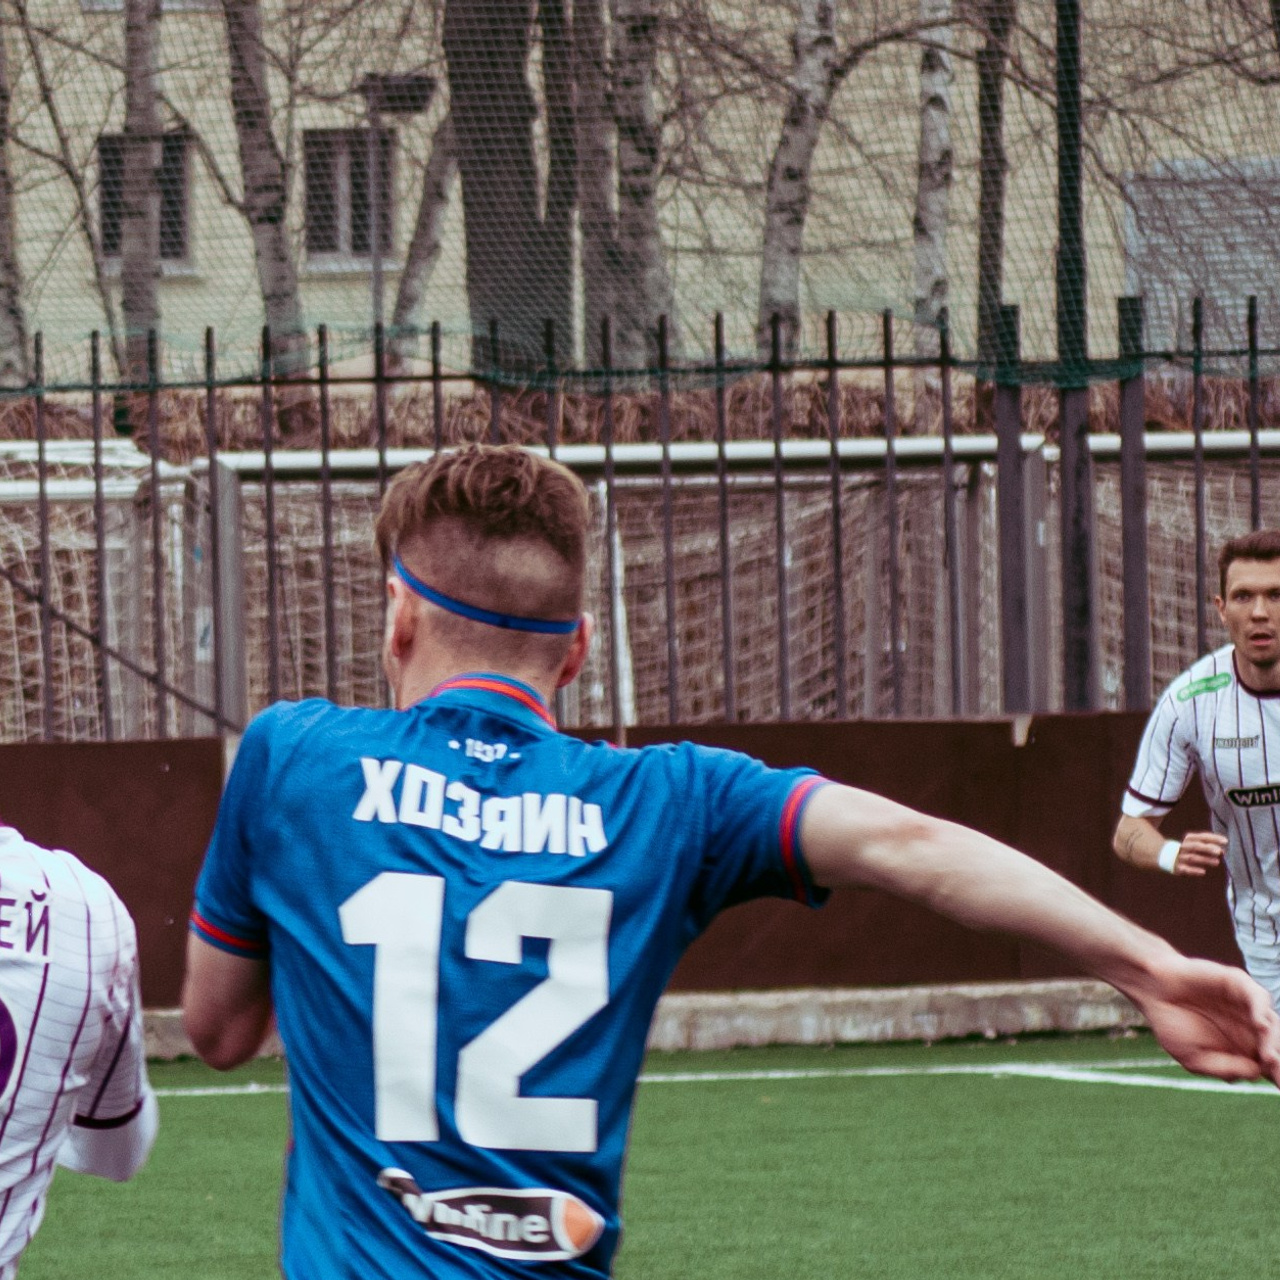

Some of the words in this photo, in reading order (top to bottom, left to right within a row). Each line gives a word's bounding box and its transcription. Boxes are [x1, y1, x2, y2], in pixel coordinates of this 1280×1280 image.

[352, 756, 608, 857] ХОЗЯИН
[1233, 788, 1280, 805] Winl
[338, 871, 613, 1152] 12
